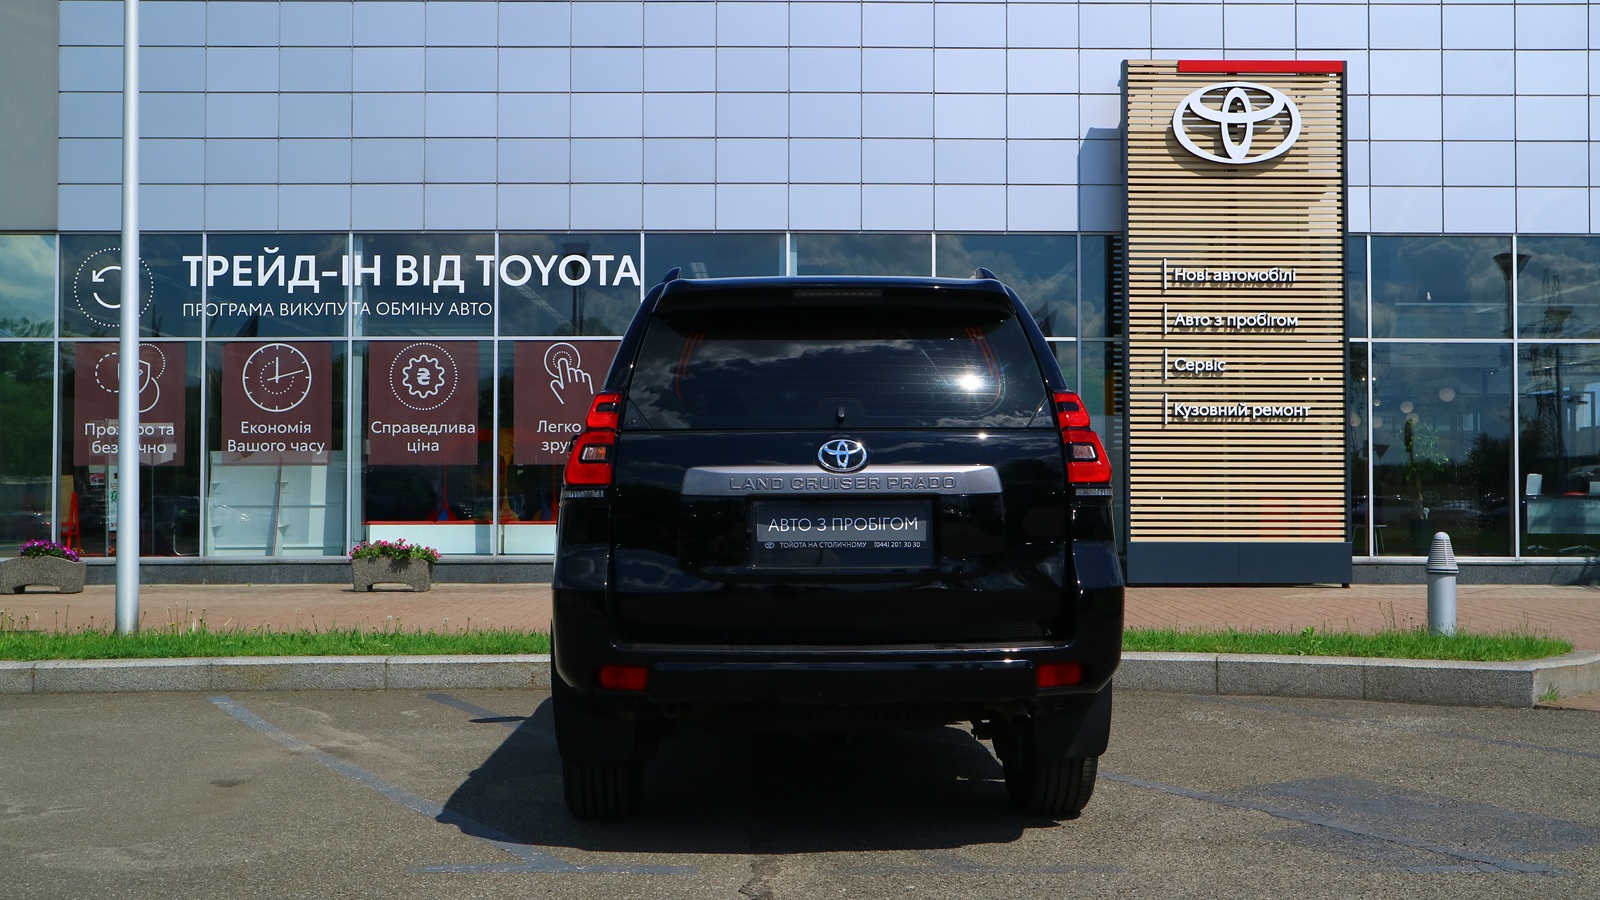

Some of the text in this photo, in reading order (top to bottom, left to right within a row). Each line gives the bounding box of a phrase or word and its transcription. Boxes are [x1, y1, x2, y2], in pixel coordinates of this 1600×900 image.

[182, 246, 641, 294] ТРЕЙД-ІН ВІД TOYOTA
[1174, 267, 1297, 282] Нові автомобілі
[183, 301, 492, 317] ПРОГРАМА ВИКУПУ ТА ОБМІНУ АВТО
[1174, 312, 1298, 330] Авто з пробігом
[1174, 358, 1226, 374] Сервіс
[1174, 402, 1312, 419] Кузовний ремонт
[158, 425, 175, 436] та
[241, 421, 312, 434] Економія
[371, 421, 476, 436] Справедлива
[536, 420, 582, 433] Легко
[91, 440, 167, 454] безчно
[227, 439, 325, 455] Вашого часу
[407, 439, 440, 453] ціна
[541, 441, 571, 454] зру
[729, 476, 957, 491] LAND CRUISER PRADO
[768, 518, 811, 532] АВТО
[832, 516, 918, 531] ПРОБІГОМ
[779, 540, 807, 549] ТОЙОТА
[819, 541, 867, 549] СТОЛИЧНОМУ
